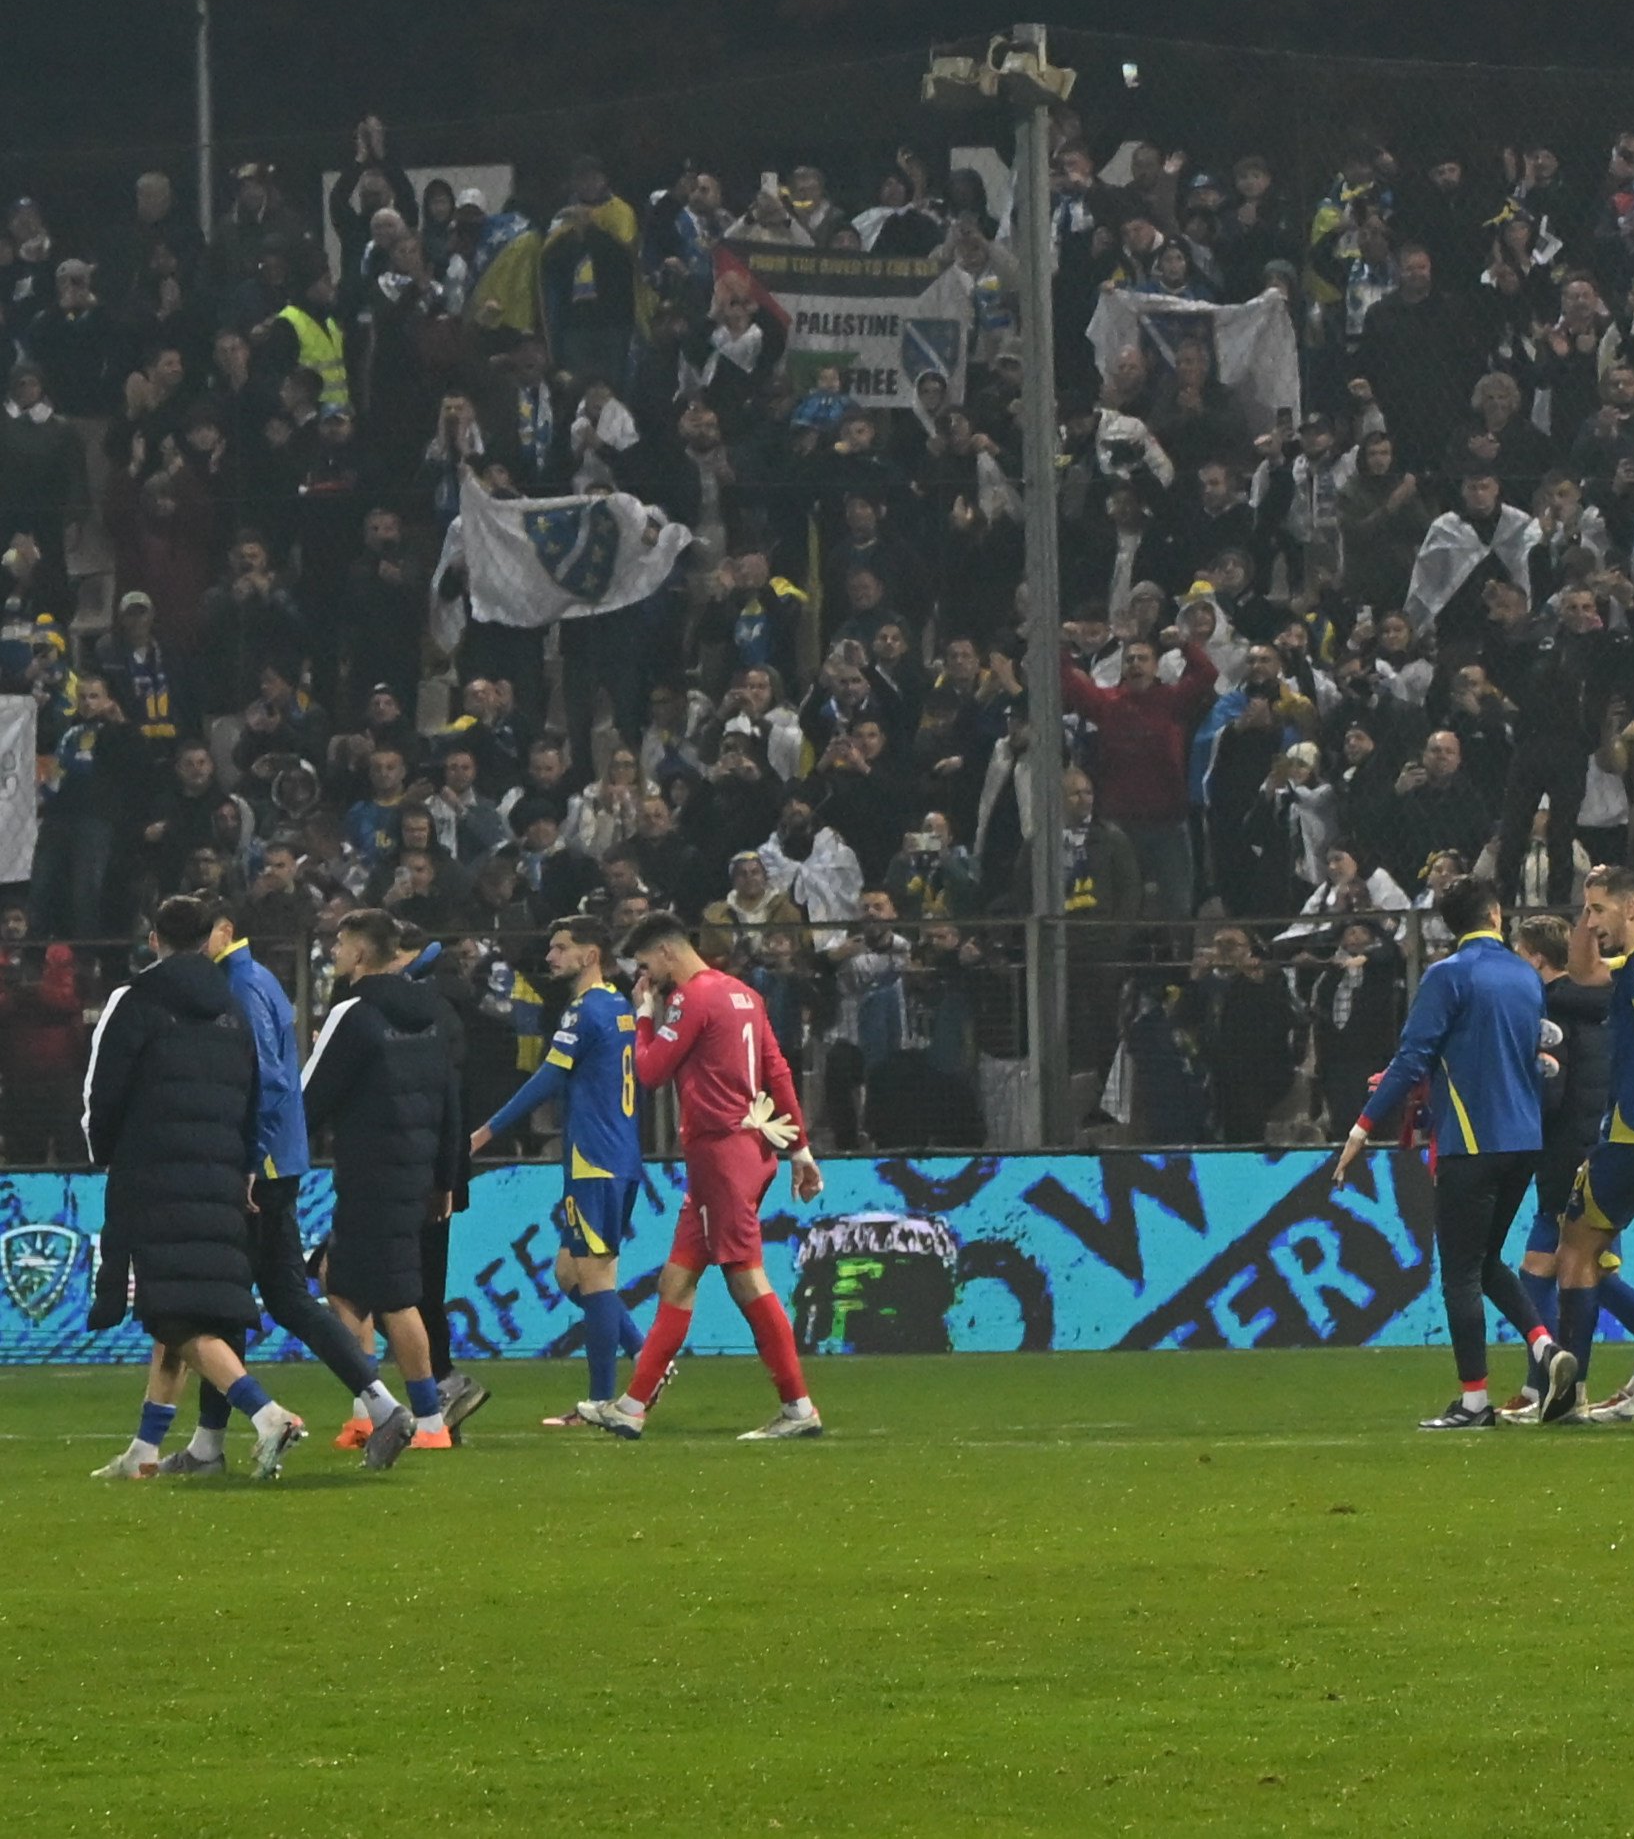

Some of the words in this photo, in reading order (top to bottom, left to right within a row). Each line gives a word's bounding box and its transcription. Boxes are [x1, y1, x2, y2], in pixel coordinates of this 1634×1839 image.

[795, 312, 900, 337] PALESTINE
[622, 1044, 636, 1117] 8
[742, 1022, 757, 1099] 1
[1170, 1156, 1427, 1349] ERY
